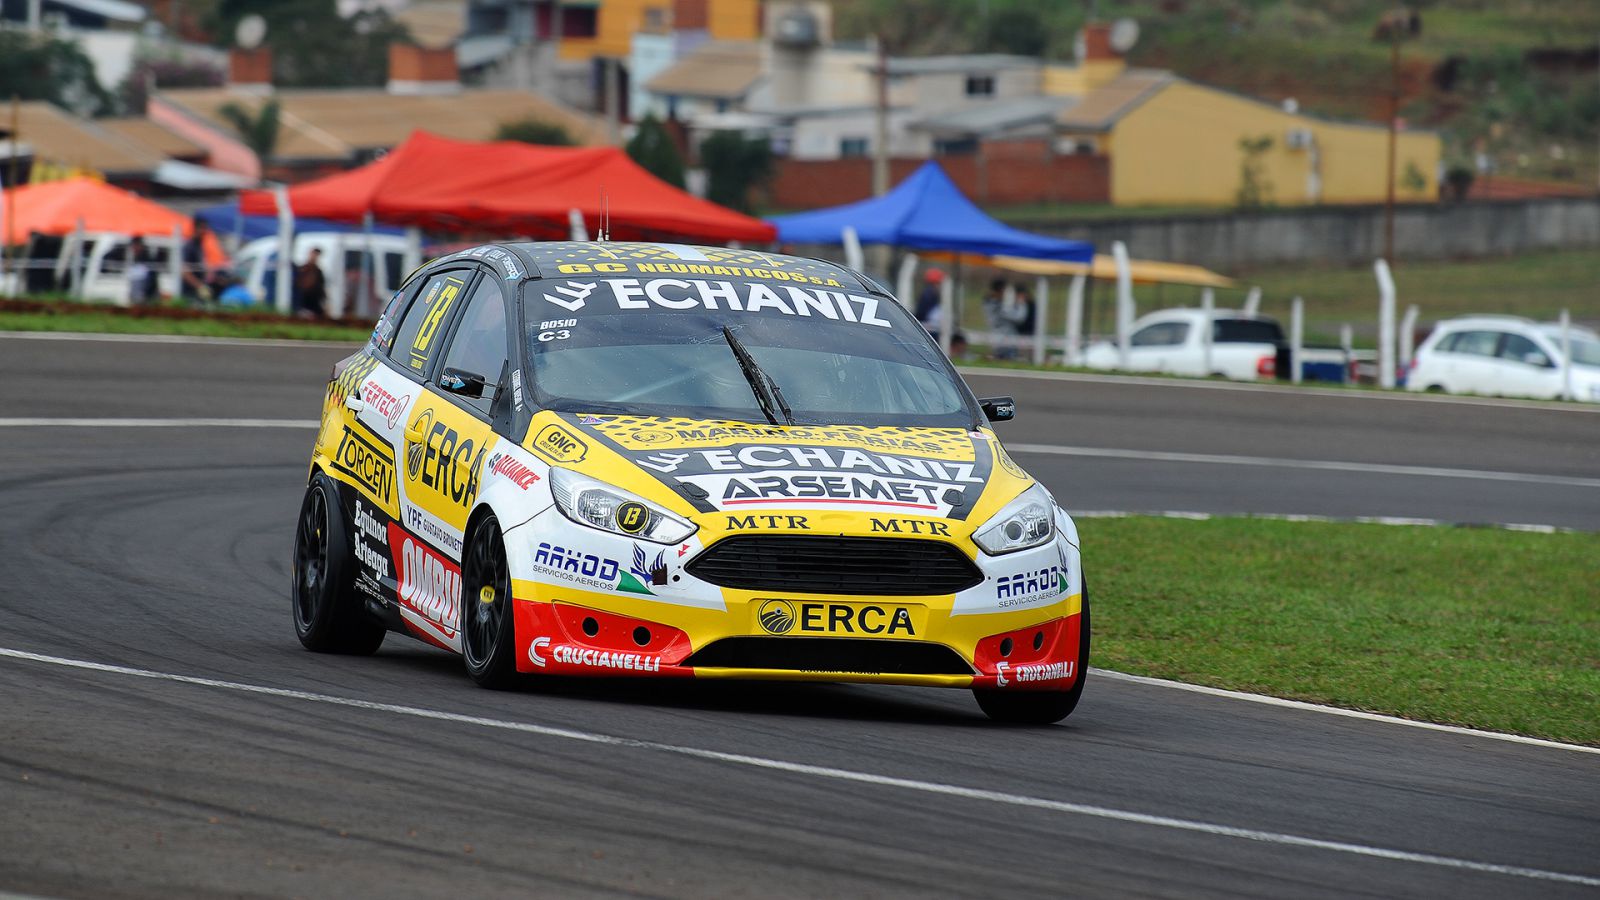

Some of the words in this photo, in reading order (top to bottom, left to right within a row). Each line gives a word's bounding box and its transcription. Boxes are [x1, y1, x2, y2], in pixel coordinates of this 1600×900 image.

[557, 263, 628, 274] GC
[636, 263, 808, 283] NEUMATICOS
[809, 275, 845, 288] S.A.
[599, 279, 892, 328] ECHANIZ
[413, 285, 458, 351] 13
[540, 319, 577, 330] BOSIO
[538, 330, 570, 341] C3
[364, 381, 396, 417] FERTEC
[548, 431, 576, 453] GNC
[335, 424, 393, 504] TORCEN
[421, 421, 488, 508] ERCA
[491, 454, 541, 491] ALLIANCE
[697, 445, 985, 483] ECHANIZ
[722, 475, 937, 502] ARSEMET
[407, 505, 422, 530] YPF
[423, 519, 443, 541] GUSTAVO
[622, 507, 639, 524] 13
[726, 515, 811, 530] MTR
[871, 518, 952, 537] MTR
[354, 532, 388, 581] Arteaga
[400, 537, 460, 634] OMBU
[532, 564, 574, 582] SERVICIOS
[574, 576, 614, 591] AEREOS
[998, 595, 1037, 608] SERVICIOS
[1036, 589, 1059, 601] AEREOS
[800, 603, 915, 635] ERCA
[553, 645, 661, 672] CRUCIANELLI
[1016, 661, 1074, 682] CRUCIANELLI
